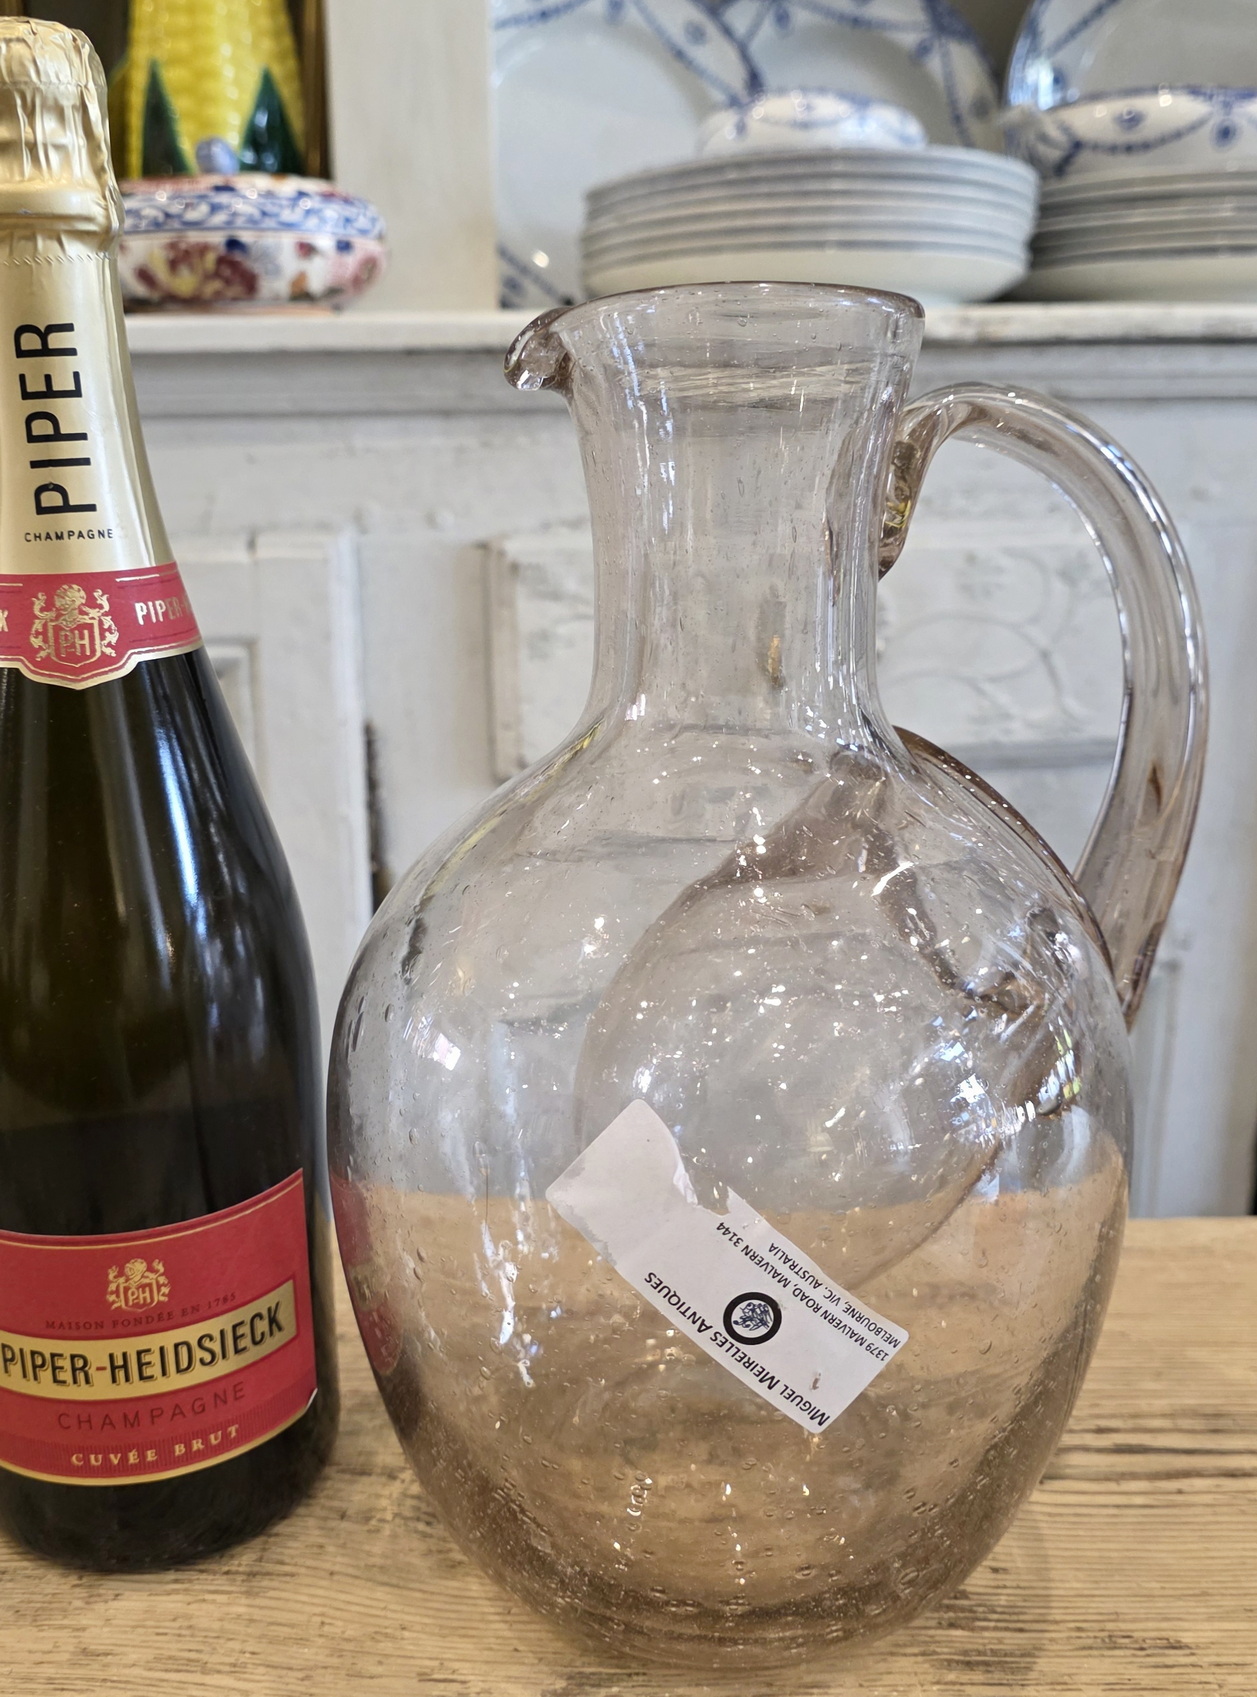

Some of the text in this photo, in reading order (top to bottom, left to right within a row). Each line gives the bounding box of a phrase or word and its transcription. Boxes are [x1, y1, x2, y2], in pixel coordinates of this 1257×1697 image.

[14, 322, 97, 515] PIPER
[24, 529, 114, 542] CHAMPAGNE
[45, 1292, 236, 1330] MAISON FONDÉE EN 1785
[716, 1222, 890, 1362] 1379 MALVERN ROAD, MALVERN 3144
[768, 1242, 902, 1349] MELBOURNE, VIC. AUSTRALIA
[1, 1301, 285, 1387] PIPER-HEIDSIECK
[644, 1271, 831, 1426] MIGUEL MEIRELLES ANTIQUES
[57, 1381, 246, 1431] CHAMPAGNE
[71, 1424, 239, 1466] CUVÉE BRUT
